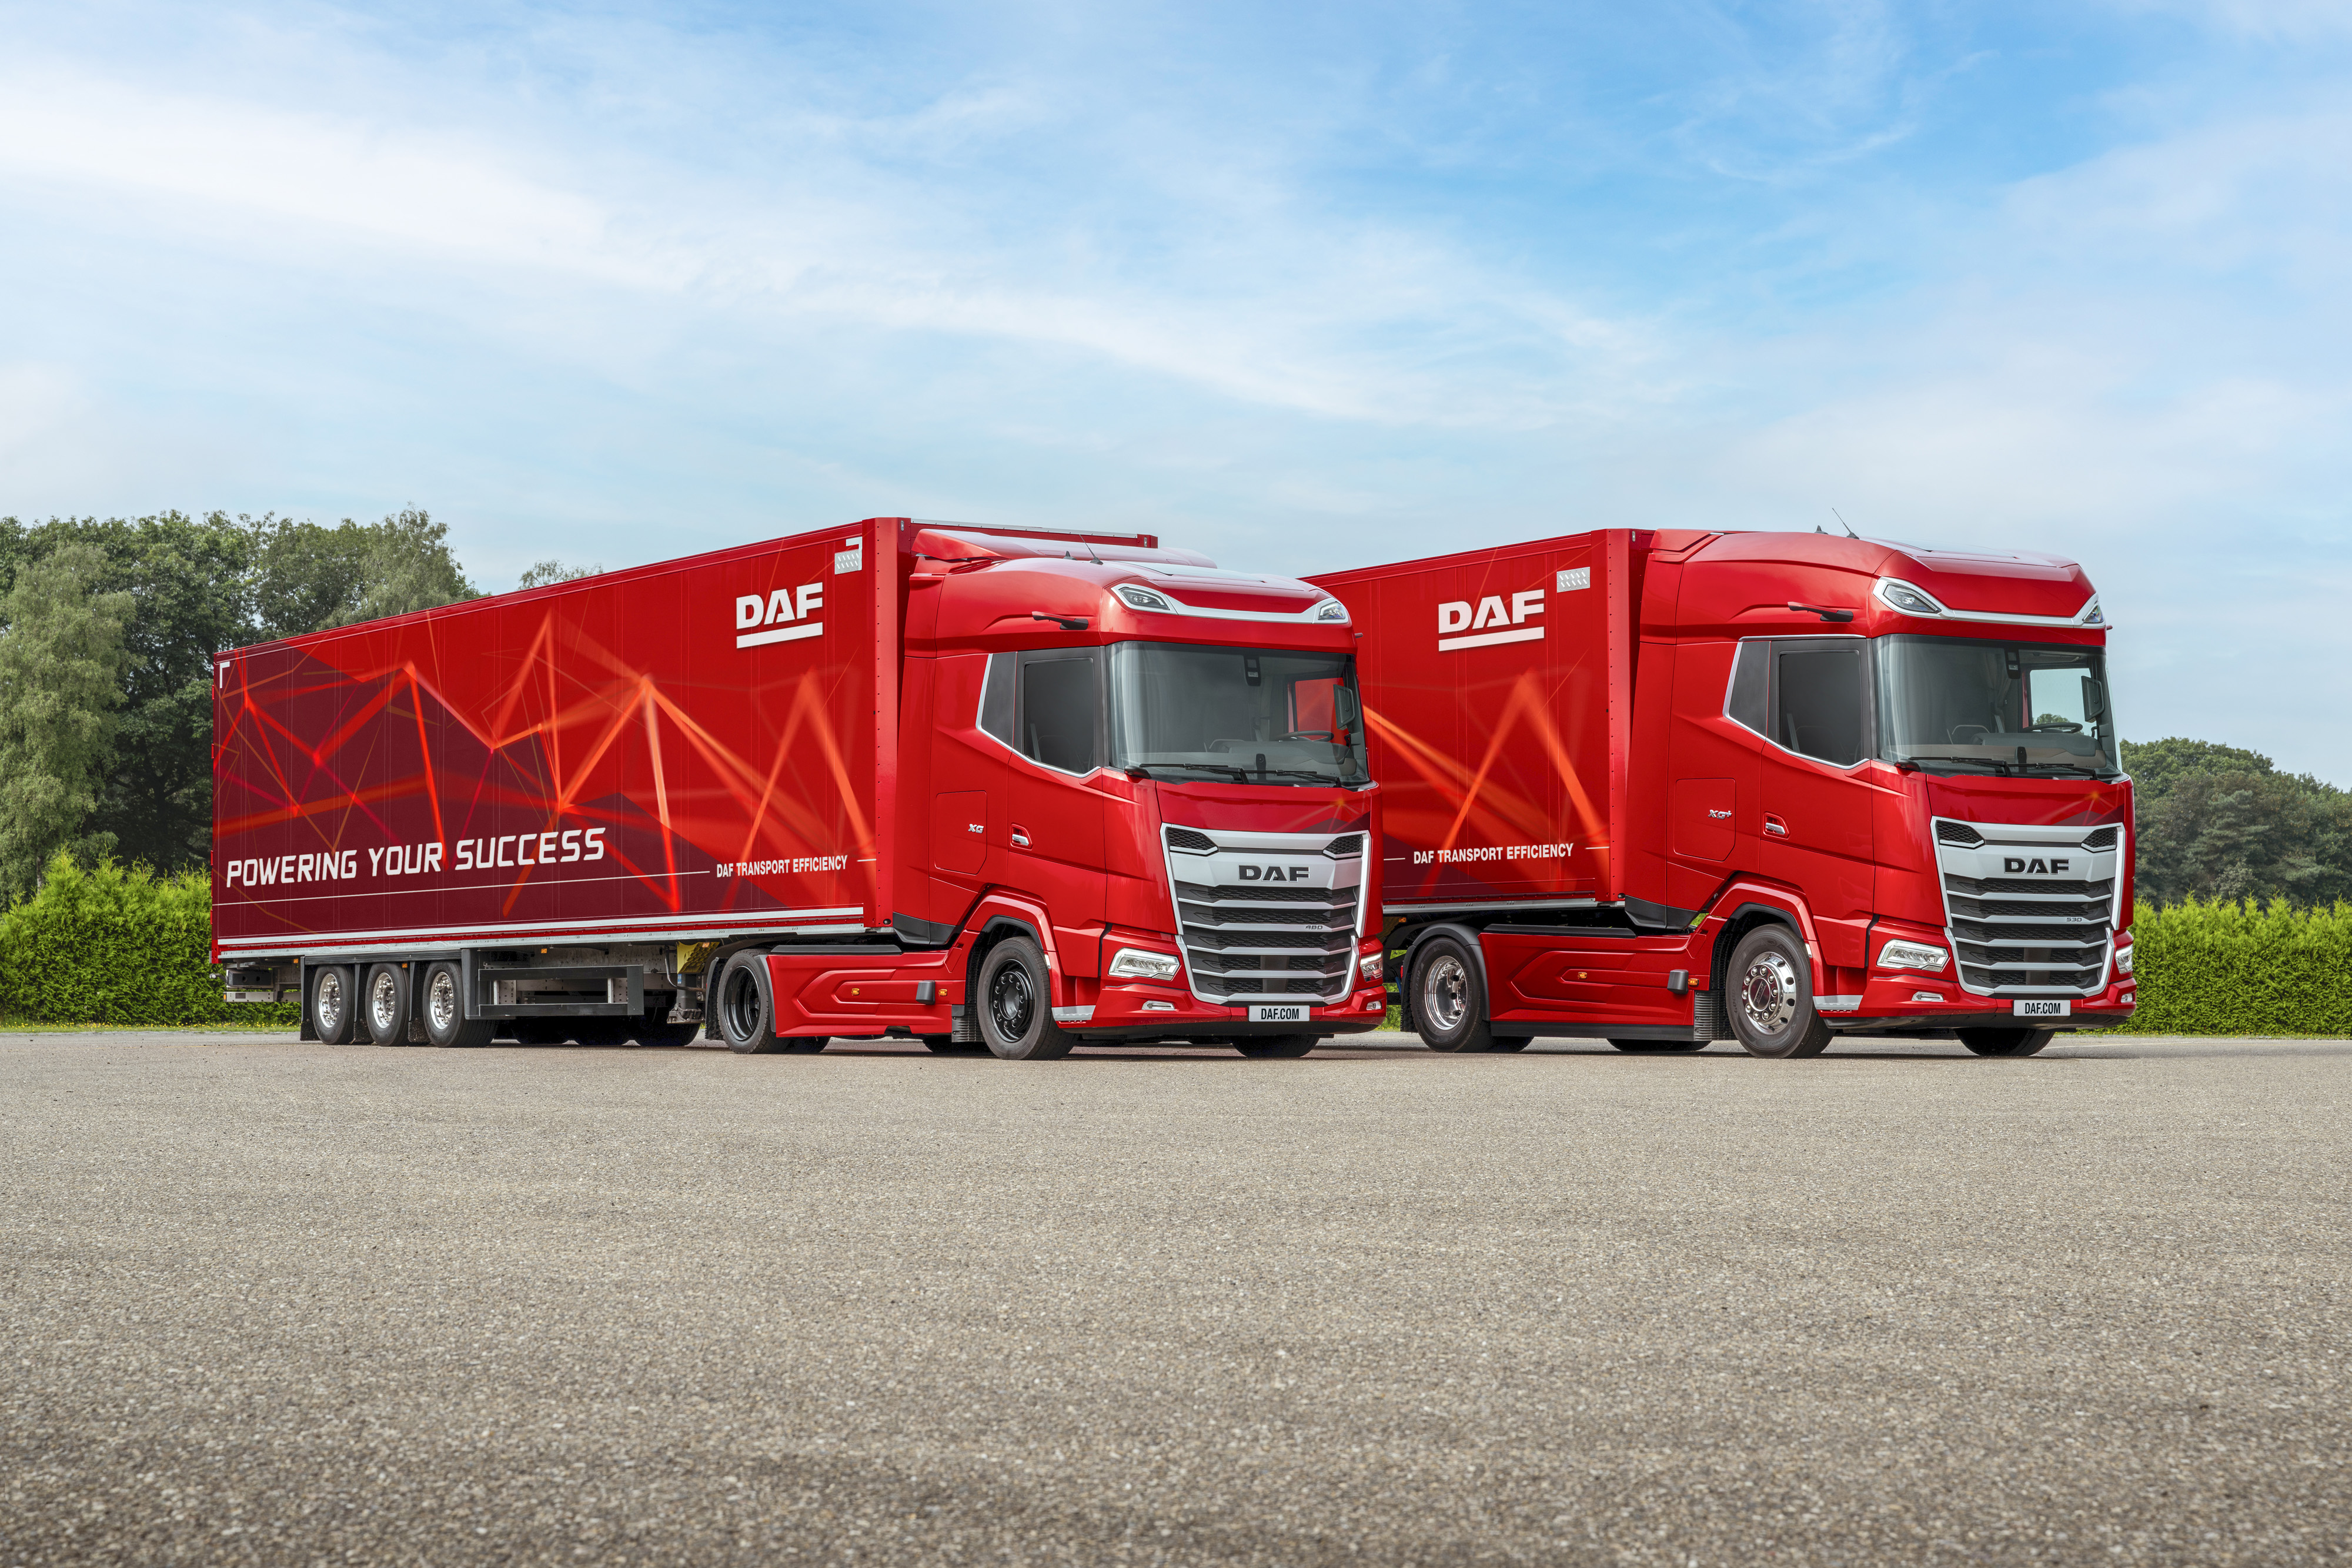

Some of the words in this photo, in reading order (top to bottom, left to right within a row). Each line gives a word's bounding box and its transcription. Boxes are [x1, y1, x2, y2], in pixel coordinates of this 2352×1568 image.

[736, 582, 823, 630] DAF
[1438, 589, 1545, 634] DAF
[968, 823, 984, 834] XG
[226, 850, 358, 888] POWERING
[368, 842, 443, 877] YOUR
[455, 827, 606, 871] SUCCESS
[1414, 850, 1434, 864] DAF
[1437, 847, 1503, 863] TRANSPORT
[1506, 842, 1573, 860] EFFICIENCY
[717, 863, 734, 878] DAF
[736, 859, 790, 876] TRANSPORT
[793, 855, 848, 873] EFFICIENCY
[1238, 865, 1309, 881] DAF
[2004, 857, 2069, 874] DAF
[1261, 1008, 1299, 1020] DAF.COM
[2024, 1002, 2061, 1014] DAF.COM
